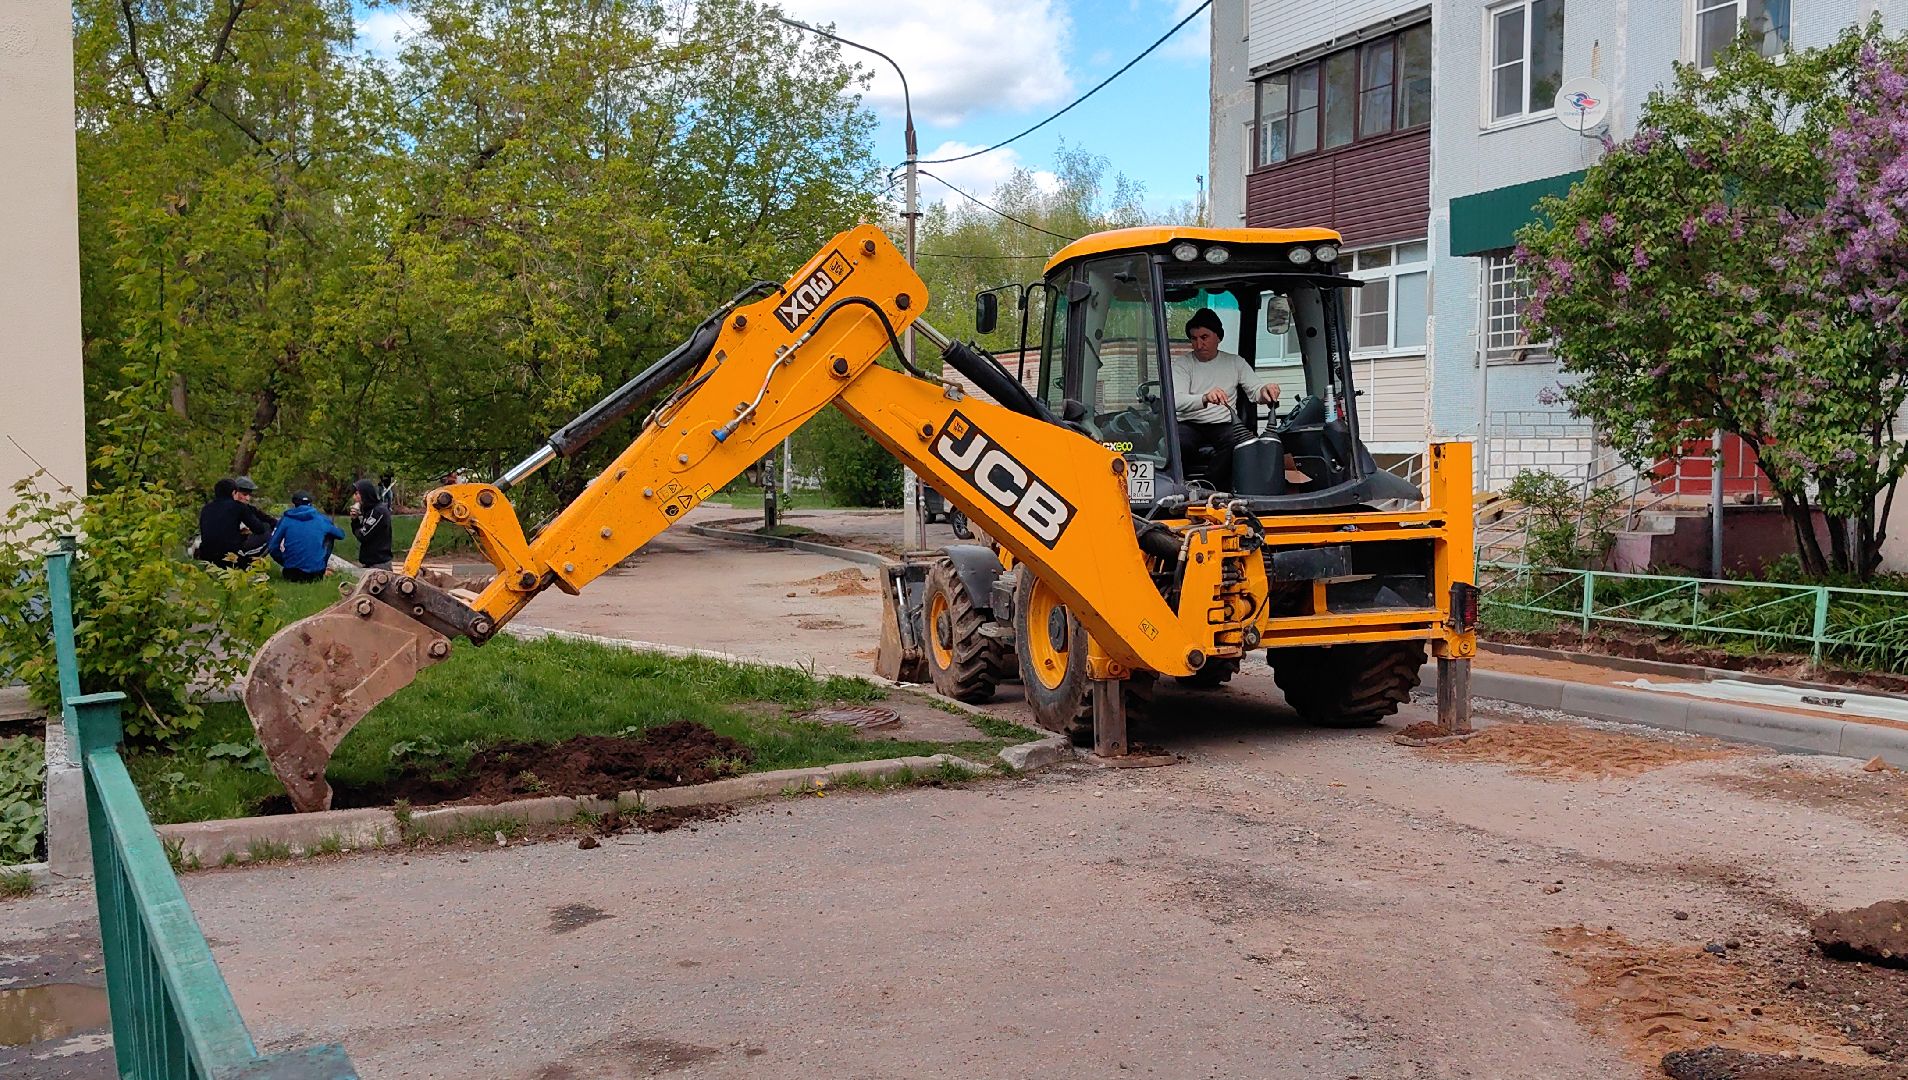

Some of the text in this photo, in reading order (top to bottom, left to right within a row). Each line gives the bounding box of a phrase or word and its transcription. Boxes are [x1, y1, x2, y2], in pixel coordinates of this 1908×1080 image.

[780, 271, 833, 326] 3CX
[937, 433, 1069, 541] JCB
[1127, 463, 1148, 478] 92
[1136, 481, 1150, 493] 77
